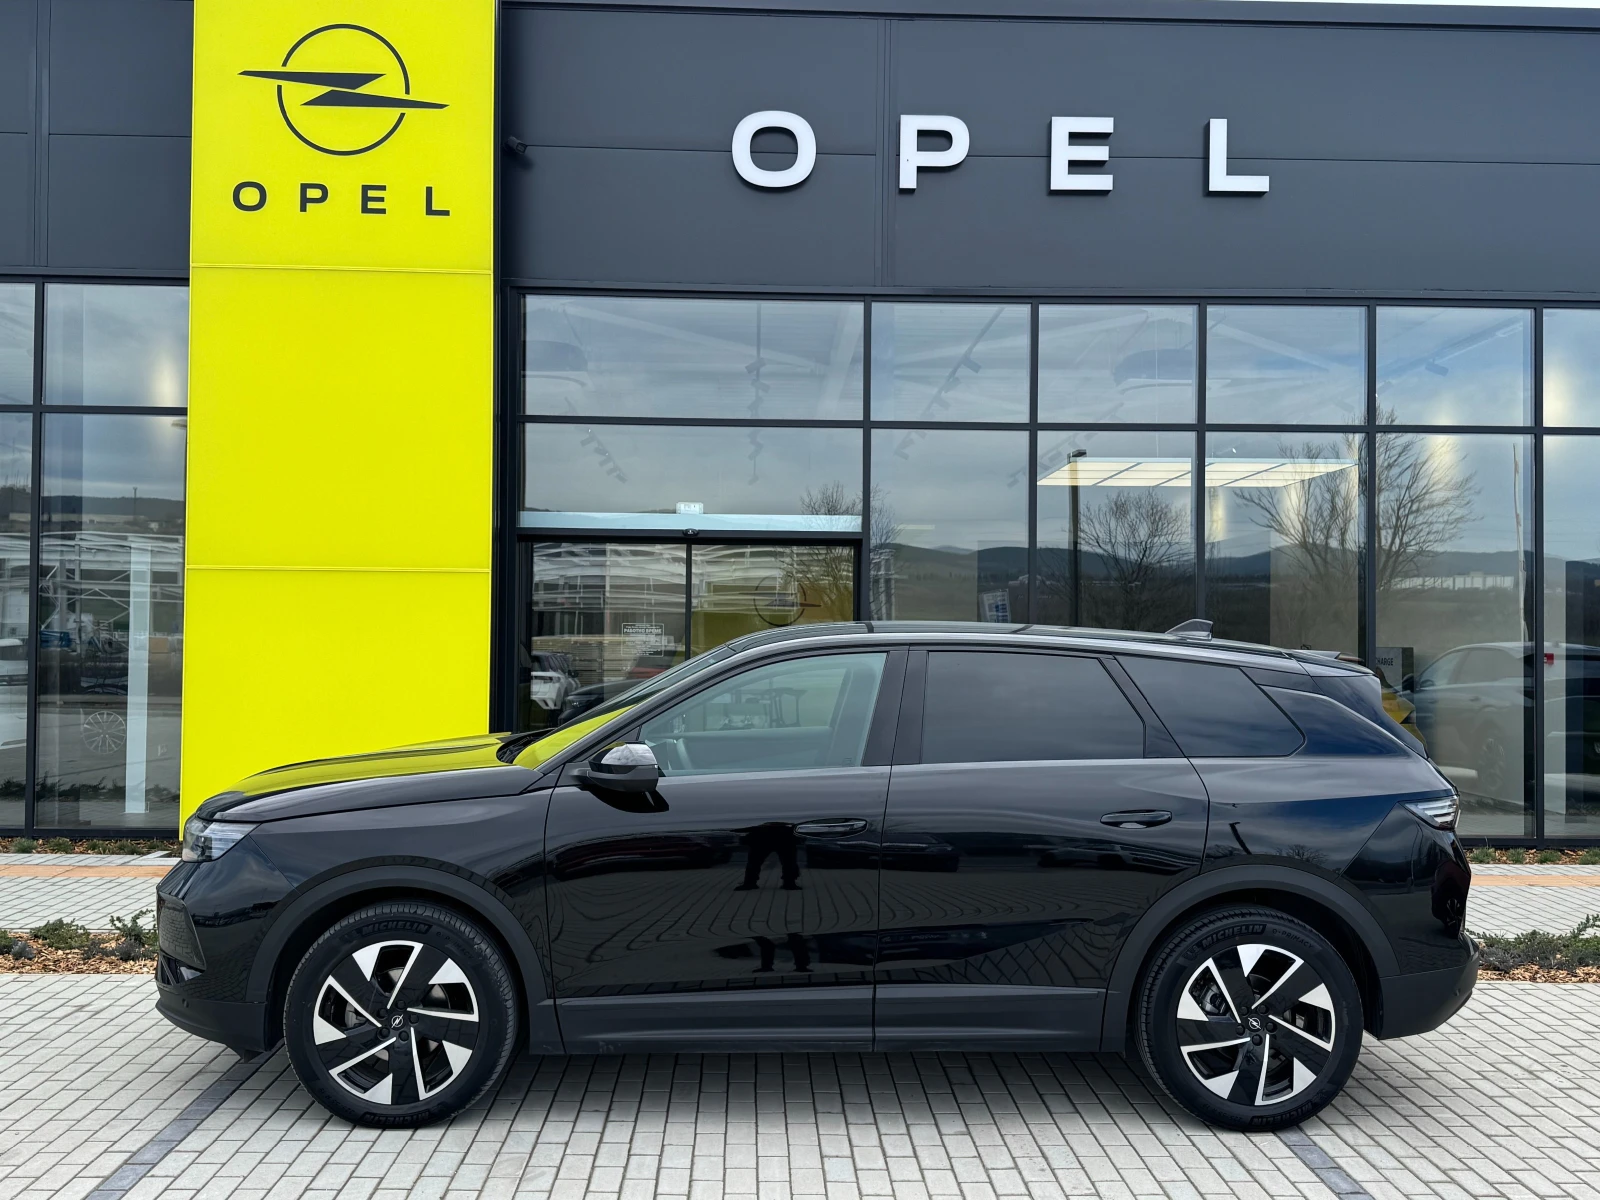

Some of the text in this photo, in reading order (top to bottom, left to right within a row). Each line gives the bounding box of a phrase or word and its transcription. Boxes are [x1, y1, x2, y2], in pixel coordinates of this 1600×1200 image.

[730, 109, 1270, 194] OPEL
[232, 180, 451, 217] OPEL
[1376, 657, 1394, 666] HARGE
[361, 920, 430, 936] MICHELIN
[1202, 924, 1264, 949] MICHELIN
